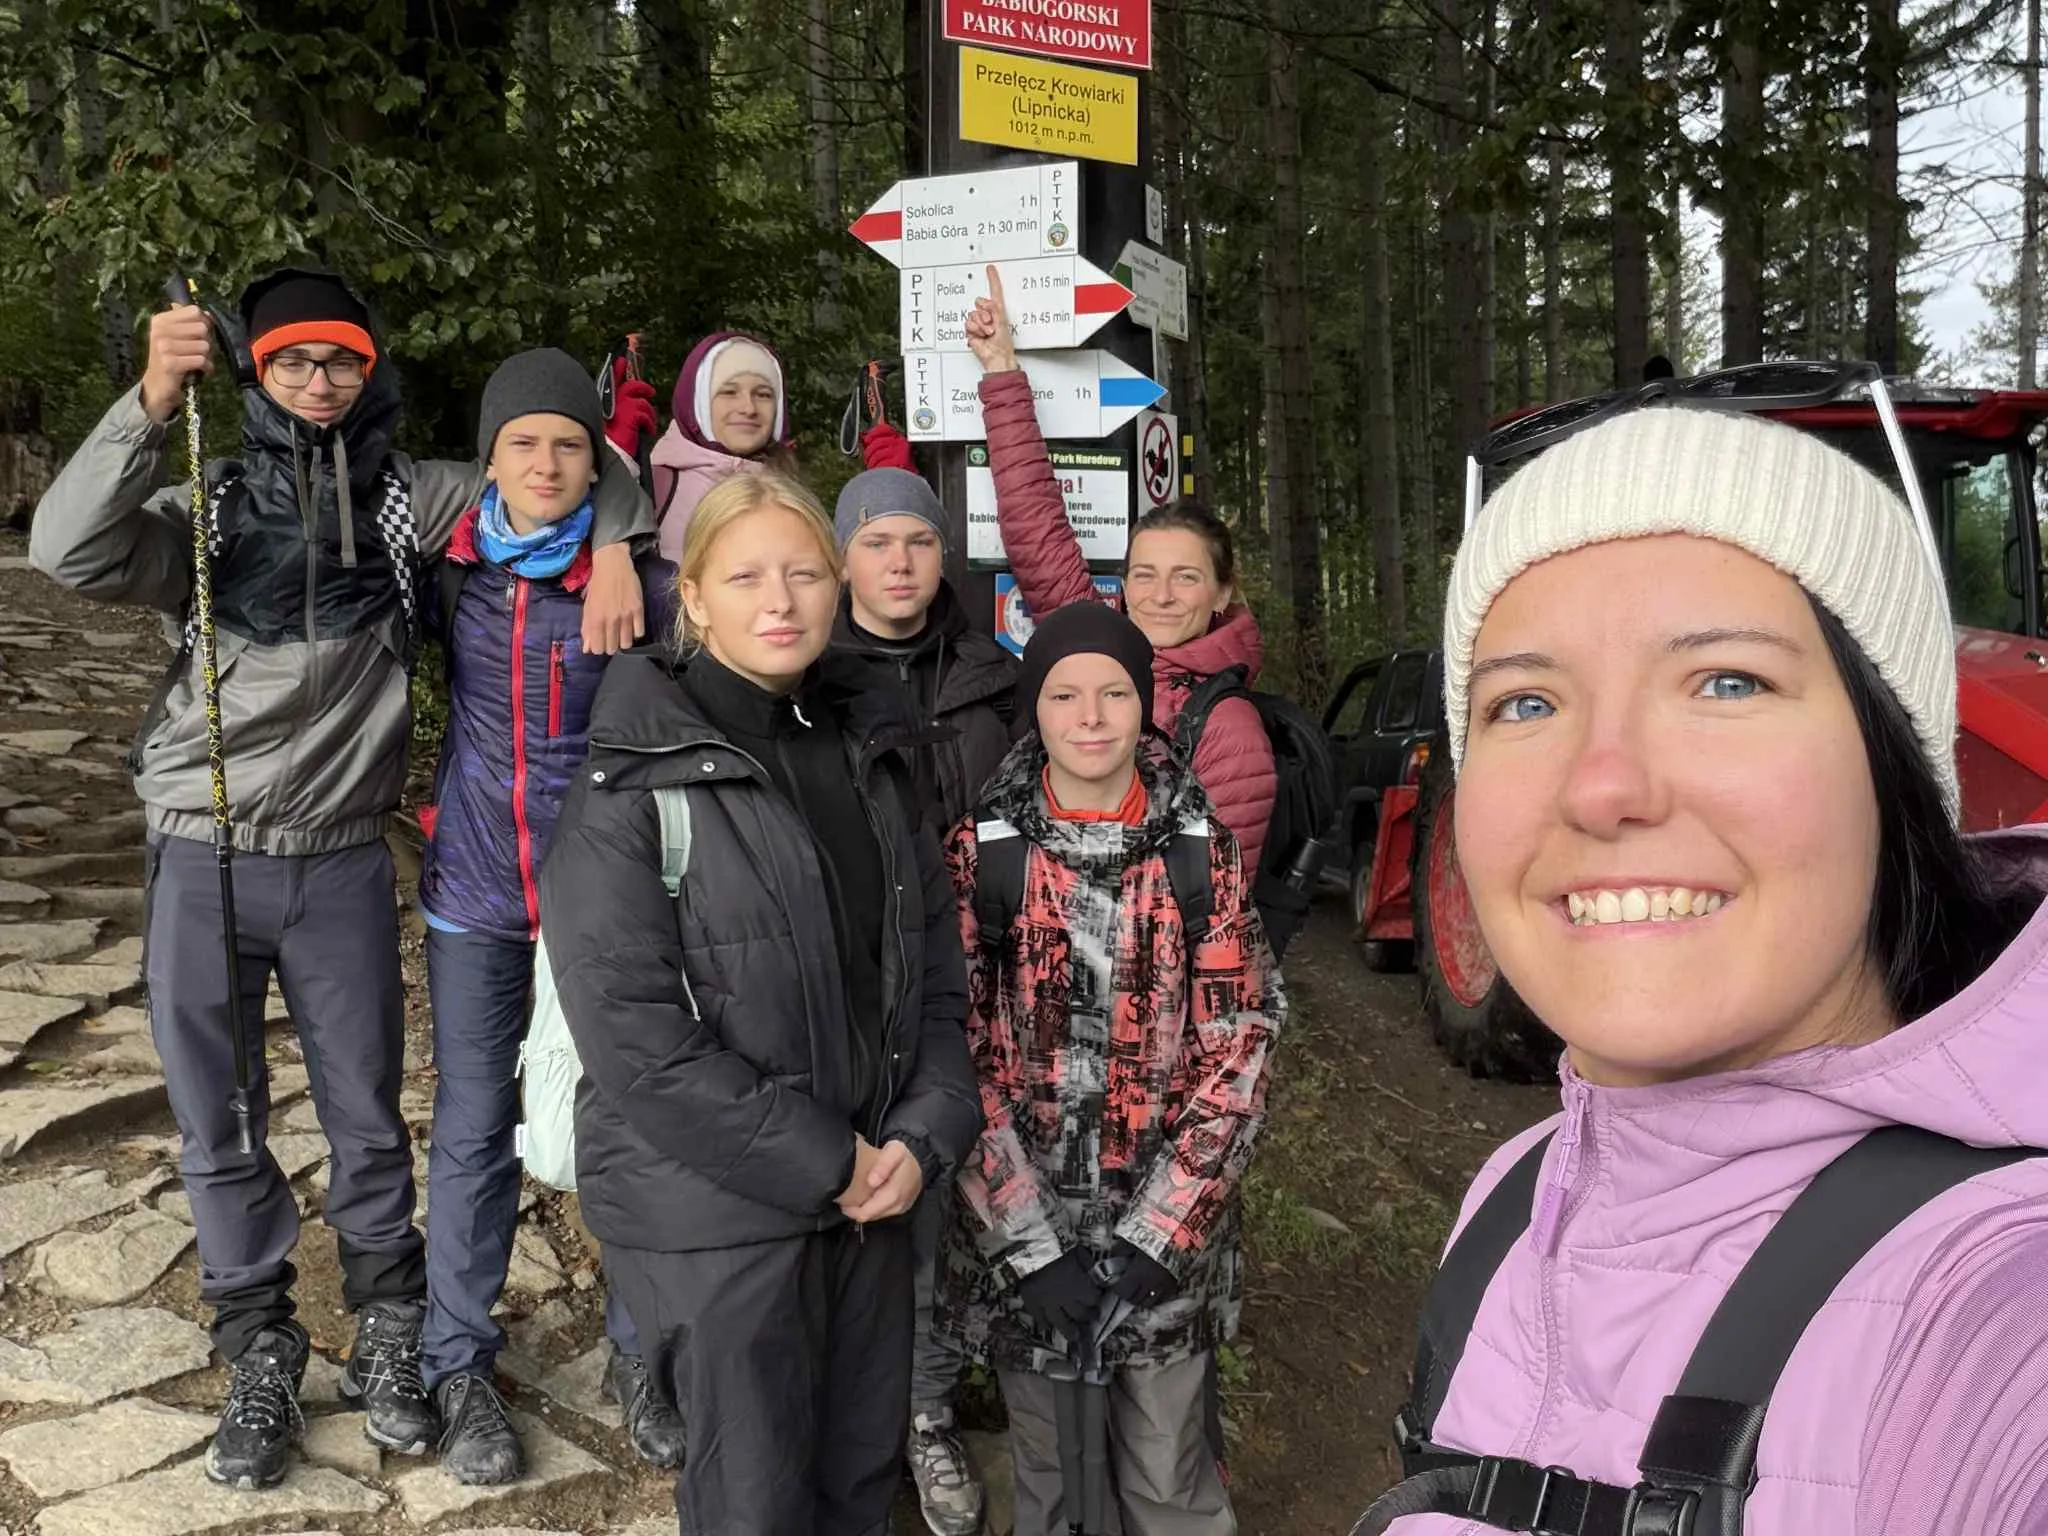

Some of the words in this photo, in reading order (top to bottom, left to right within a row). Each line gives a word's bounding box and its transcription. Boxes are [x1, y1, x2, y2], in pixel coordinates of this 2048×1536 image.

[962, 11, 1016, 38] PARK
[1020, 21, 1137, 55] NARODOWY
[976, 64, 1046, 92] Przełęcz
[1051, 77, 1124, 104] Krowiarki
[1012, 95, 1090, 126] (Lipnicka)
[1009, 119, 1038, 136] 1012
[1042, 126, 1053, 137] m
[1056, 129, 1094, 144] n.p.m.
[1030, 194, 1038, 207] h
[1053, 170, 1062, 221] PTTK
[906, 204, 954, 219] Sokolica
[906, 226, 938, 241] Babia
[941, 224, 969, 238] Góra
[977, 222, 985, 235] 2
[988, 221, 996, 234] h
[999, 220, 1013, 233] 30
[1016, 218, 1038, 232] min
[937, 283, 965, 296] Polica
[1022, 278, 1029, 290] 2
[1030, 276, 1037, 289] h
[1040, 275, 1051, 288] 15
[1053, 273, 1070, 288] min
[911, 274, 923, 342] PTTK
[937, 310, 959, 323] Hala
[1022, 312, 1029, 325] 2
[1030, 311, 1037, 324] h
[1039, 311, 1051, 324] 45
[1053, 309, 1070, 322] min
[936, 328, 967, 342] Schro
[917, 358, 929, 406] PTTK
[1053, 453, 1075, 464] Park
[1076, 454, 1121, 466] Narodowy
